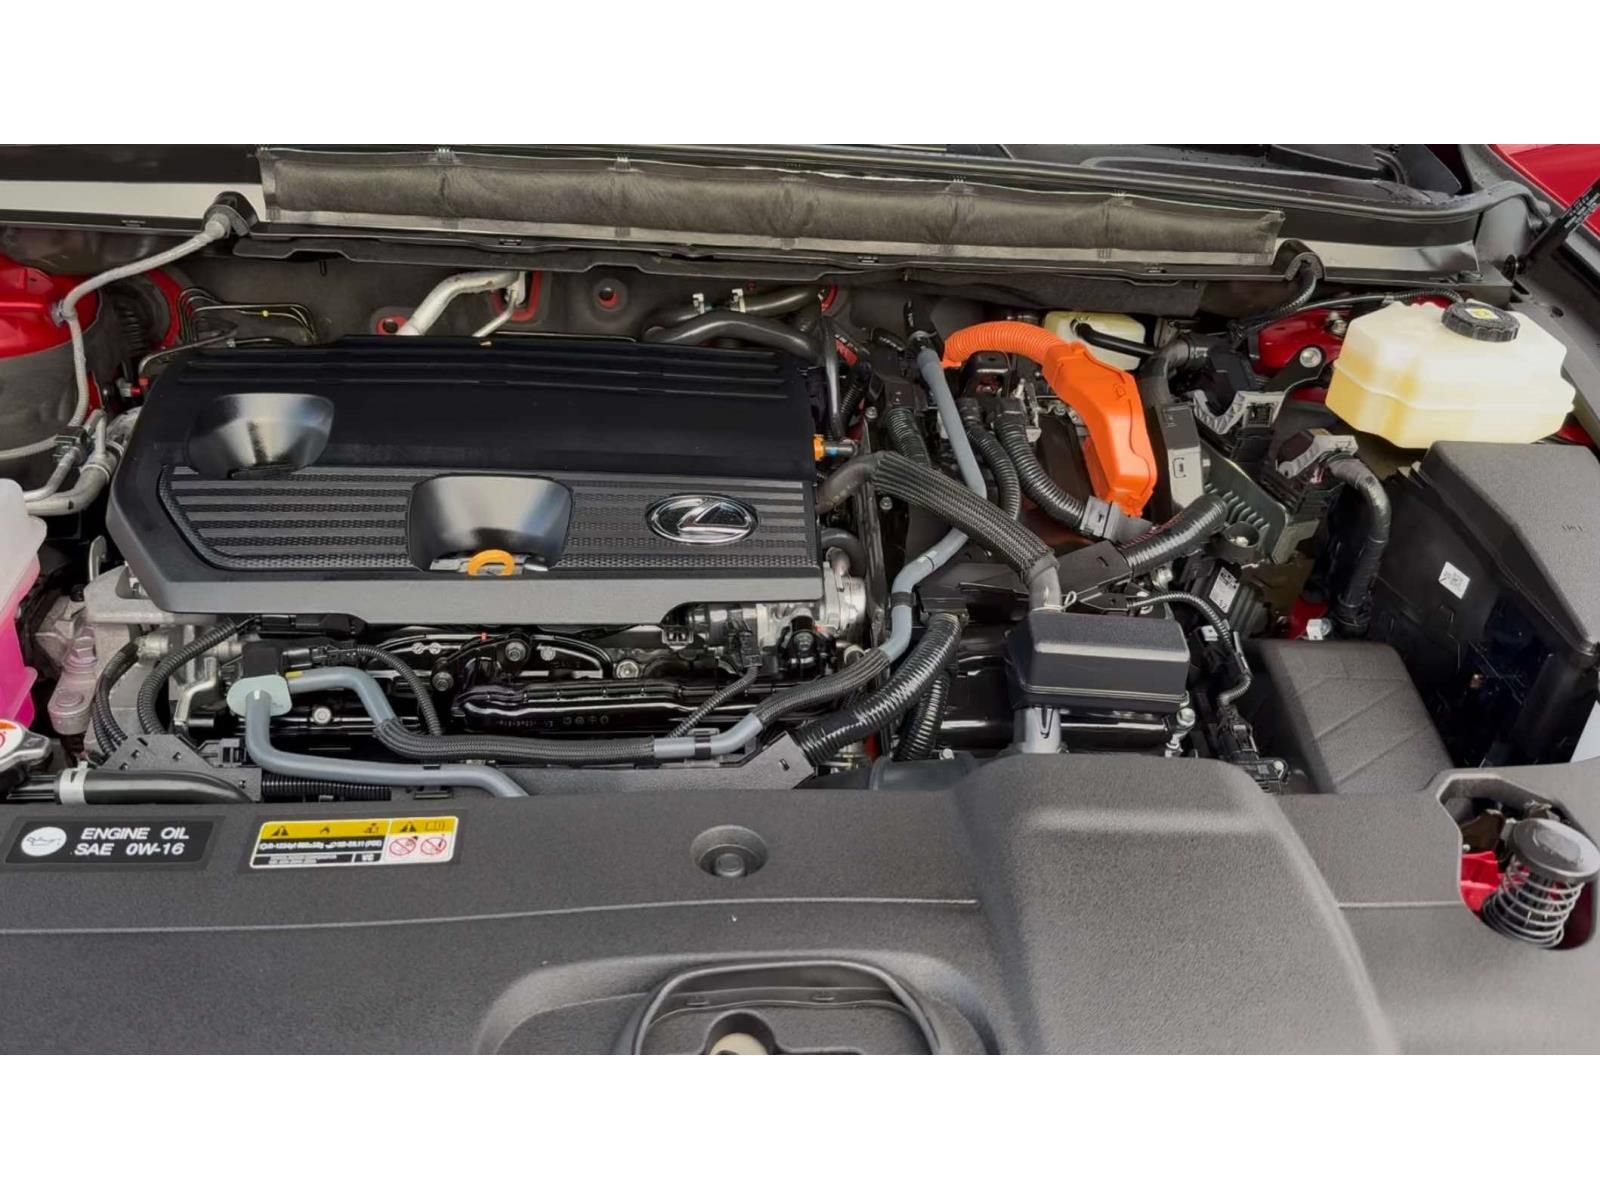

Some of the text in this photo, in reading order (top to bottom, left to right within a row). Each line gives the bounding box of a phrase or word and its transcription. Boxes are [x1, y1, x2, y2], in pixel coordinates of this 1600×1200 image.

[81, 827, 190, 840] ENGINE OIL
[74, 842, 185, 856] SAE 0W-16
